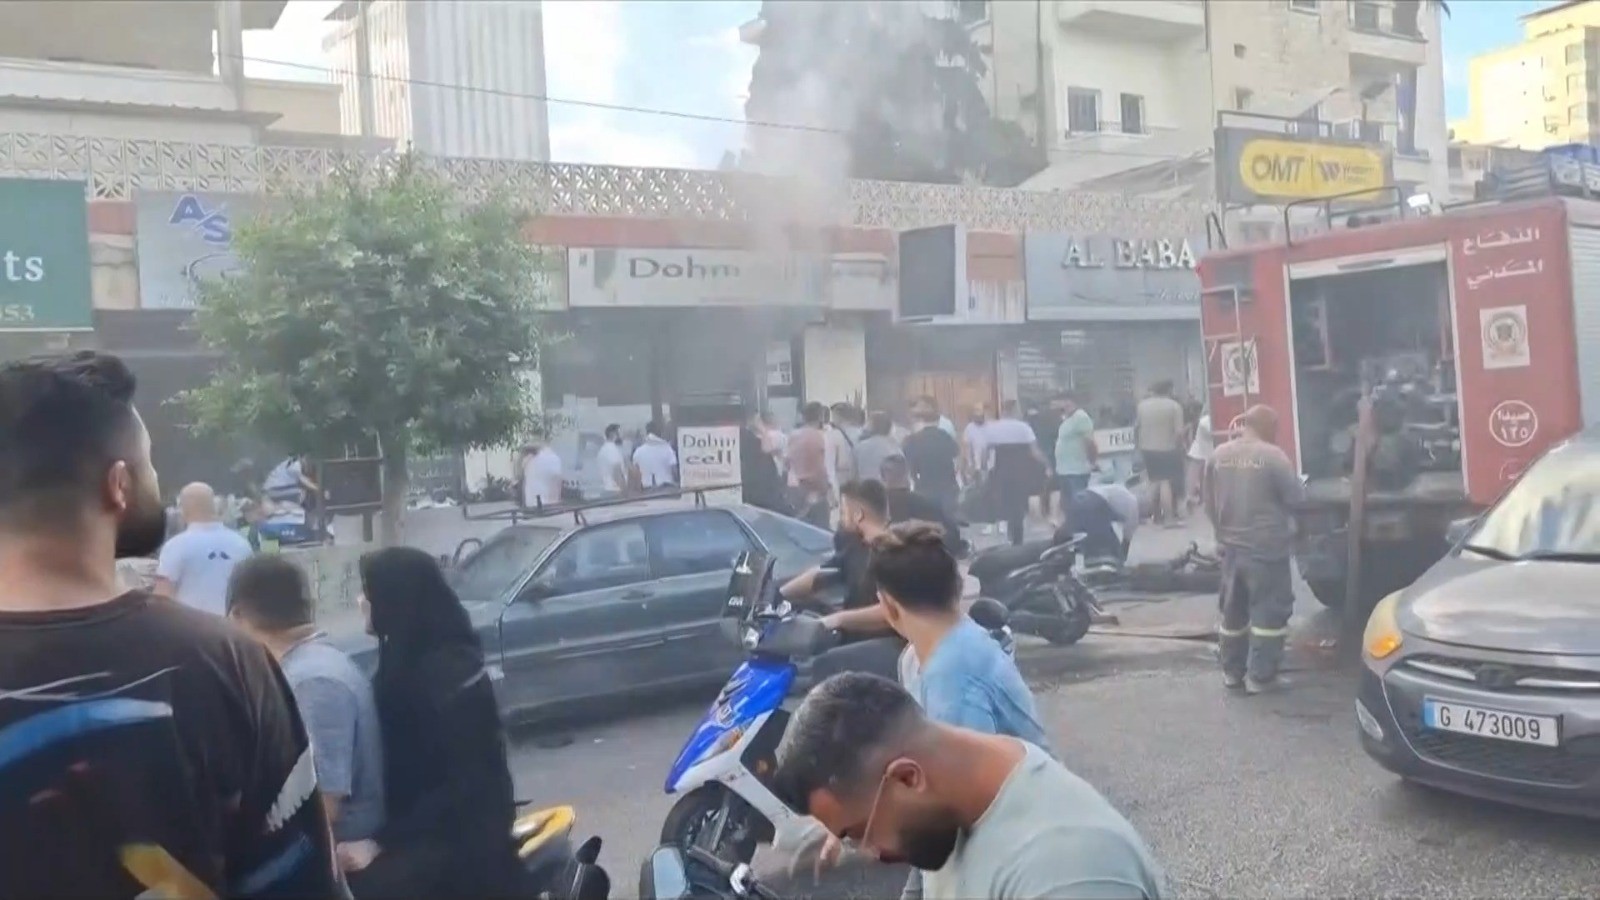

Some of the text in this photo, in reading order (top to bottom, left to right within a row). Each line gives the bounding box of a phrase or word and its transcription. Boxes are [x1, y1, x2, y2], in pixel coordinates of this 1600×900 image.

[1252, 154, 1305, 181] OMT
[1061, 236, 1197, 270] AL BABA
[1463, 227, 1540, 255] الدفاع
[1466, 259, 1543, 289] المدني
[686, 450, 732, 465] cell
[1440, 706, 1541, 740] G 473009
